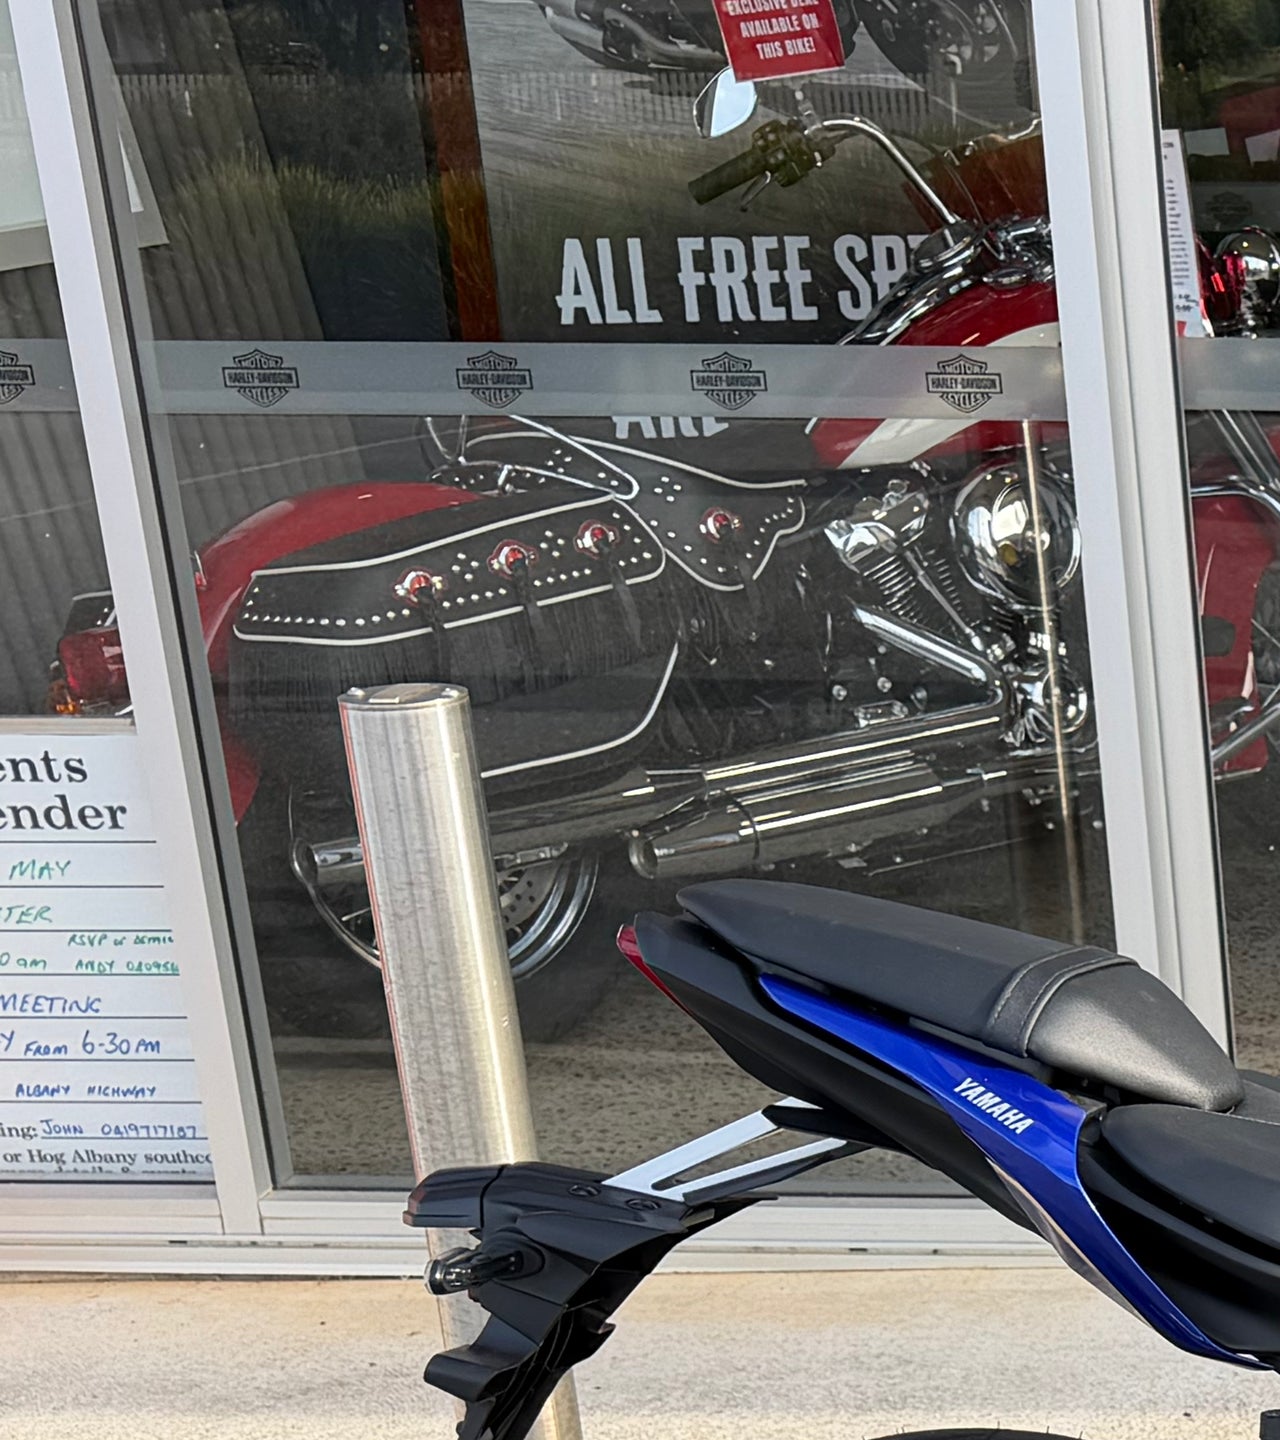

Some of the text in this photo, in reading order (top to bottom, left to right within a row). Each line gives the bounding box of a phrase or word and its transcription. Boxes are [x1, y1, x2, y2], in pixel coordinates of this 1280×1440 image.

[740, 13, 819, 38] AVAILABLE ON
[756, 37, 816, 59] THIS BIKE!
[555, 233, 930, 325] ALL FREE SP
[9, 859, 72, 881] MAY
[0, 905, 53, 924] TER
[82, 1030, 130, 1055] 6-30
[15, 1083, 71, 1098] ALBANY
[954, 1077, 1034, 1135] YAMAHA
[40, 1119, 84, 1136] JOHN
[3, 1152, 21, 1163] or
[28, 1149, 66, 1165] Hog
[72, 1149, 137, 1166] Albany
